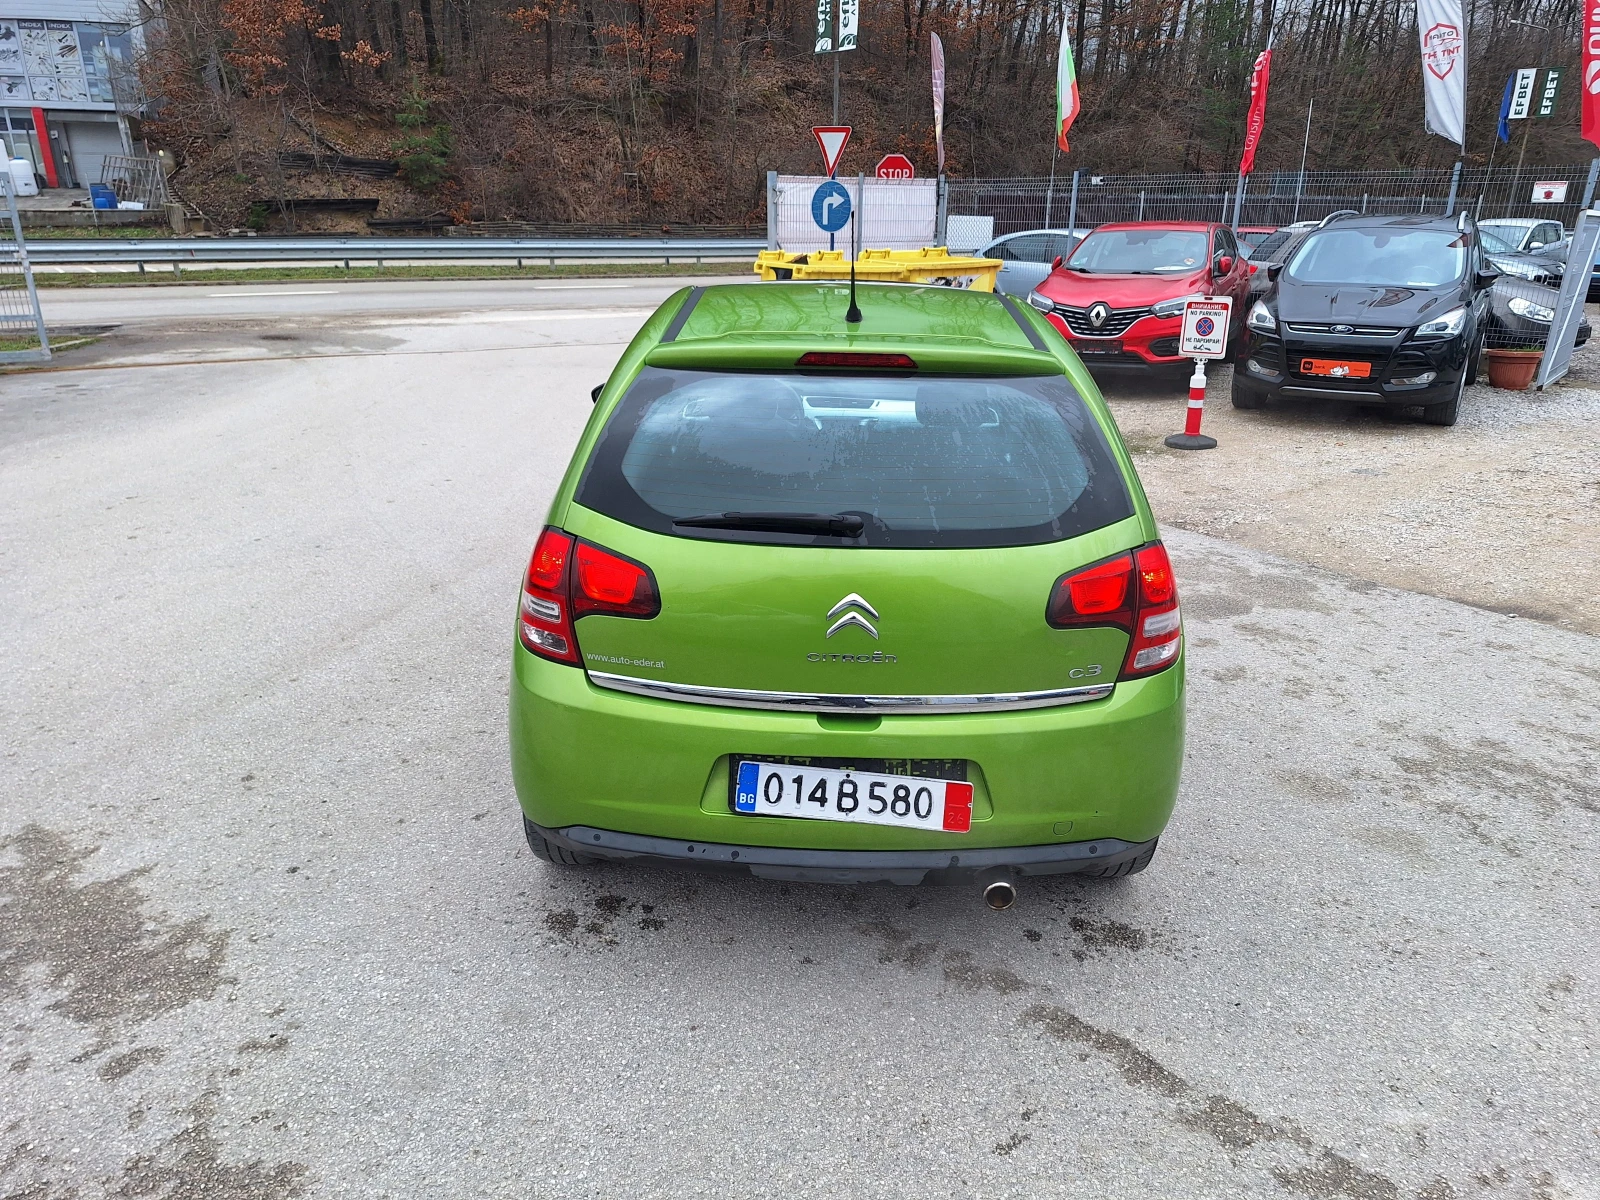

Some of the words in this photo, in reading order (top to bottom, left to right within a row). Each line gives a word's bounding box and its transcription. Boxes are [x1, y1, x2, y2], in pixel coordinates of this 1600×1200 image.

[1513, 72, 1531, 116] EFBET
[1540, 70, 1559, 115] EFBET
[880, 169, 910, 179] STOP
[586, 652, 665, 669] www.auto-eder.at
[739, 793, 755, 804] BG
[948, 812, 964, 824] 26
